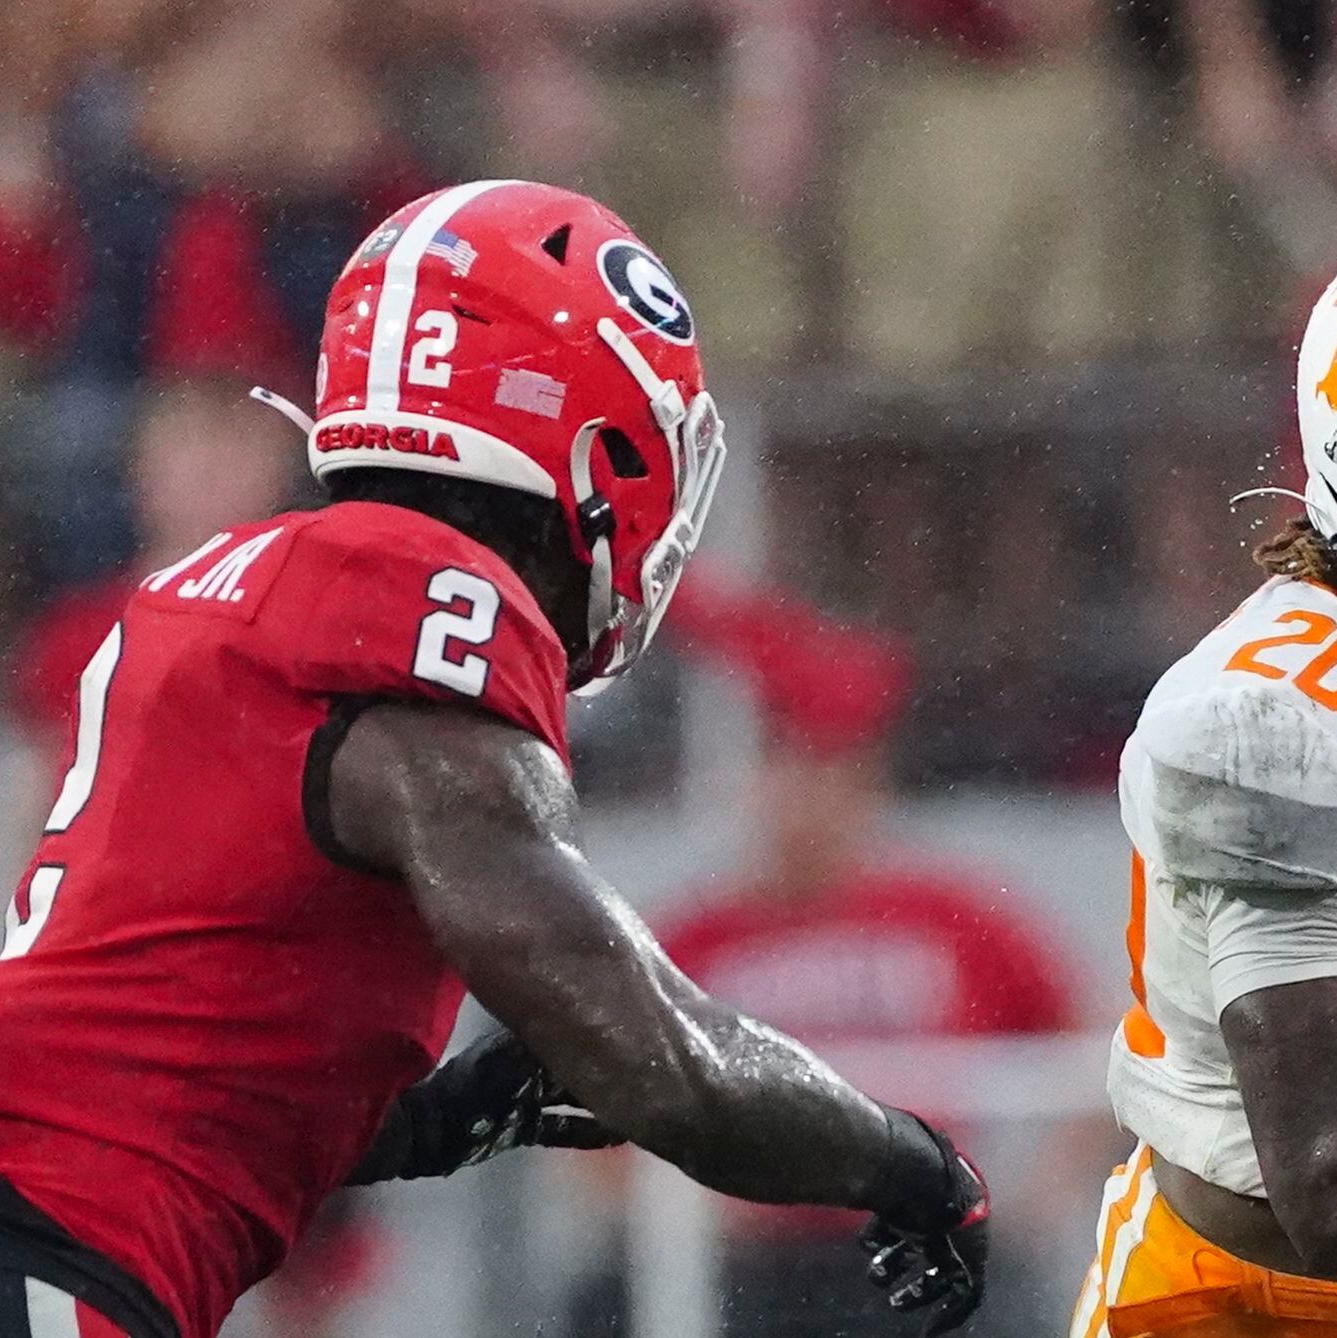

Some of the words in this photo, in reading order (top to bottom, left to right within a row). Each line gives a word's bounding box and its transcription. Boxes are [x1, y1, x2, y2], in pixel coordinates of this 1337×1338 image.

[407, 309, 459, 389] 2
[315, 422, 461, 462] GEORGIA
[412, 567, 500, 698] 2
